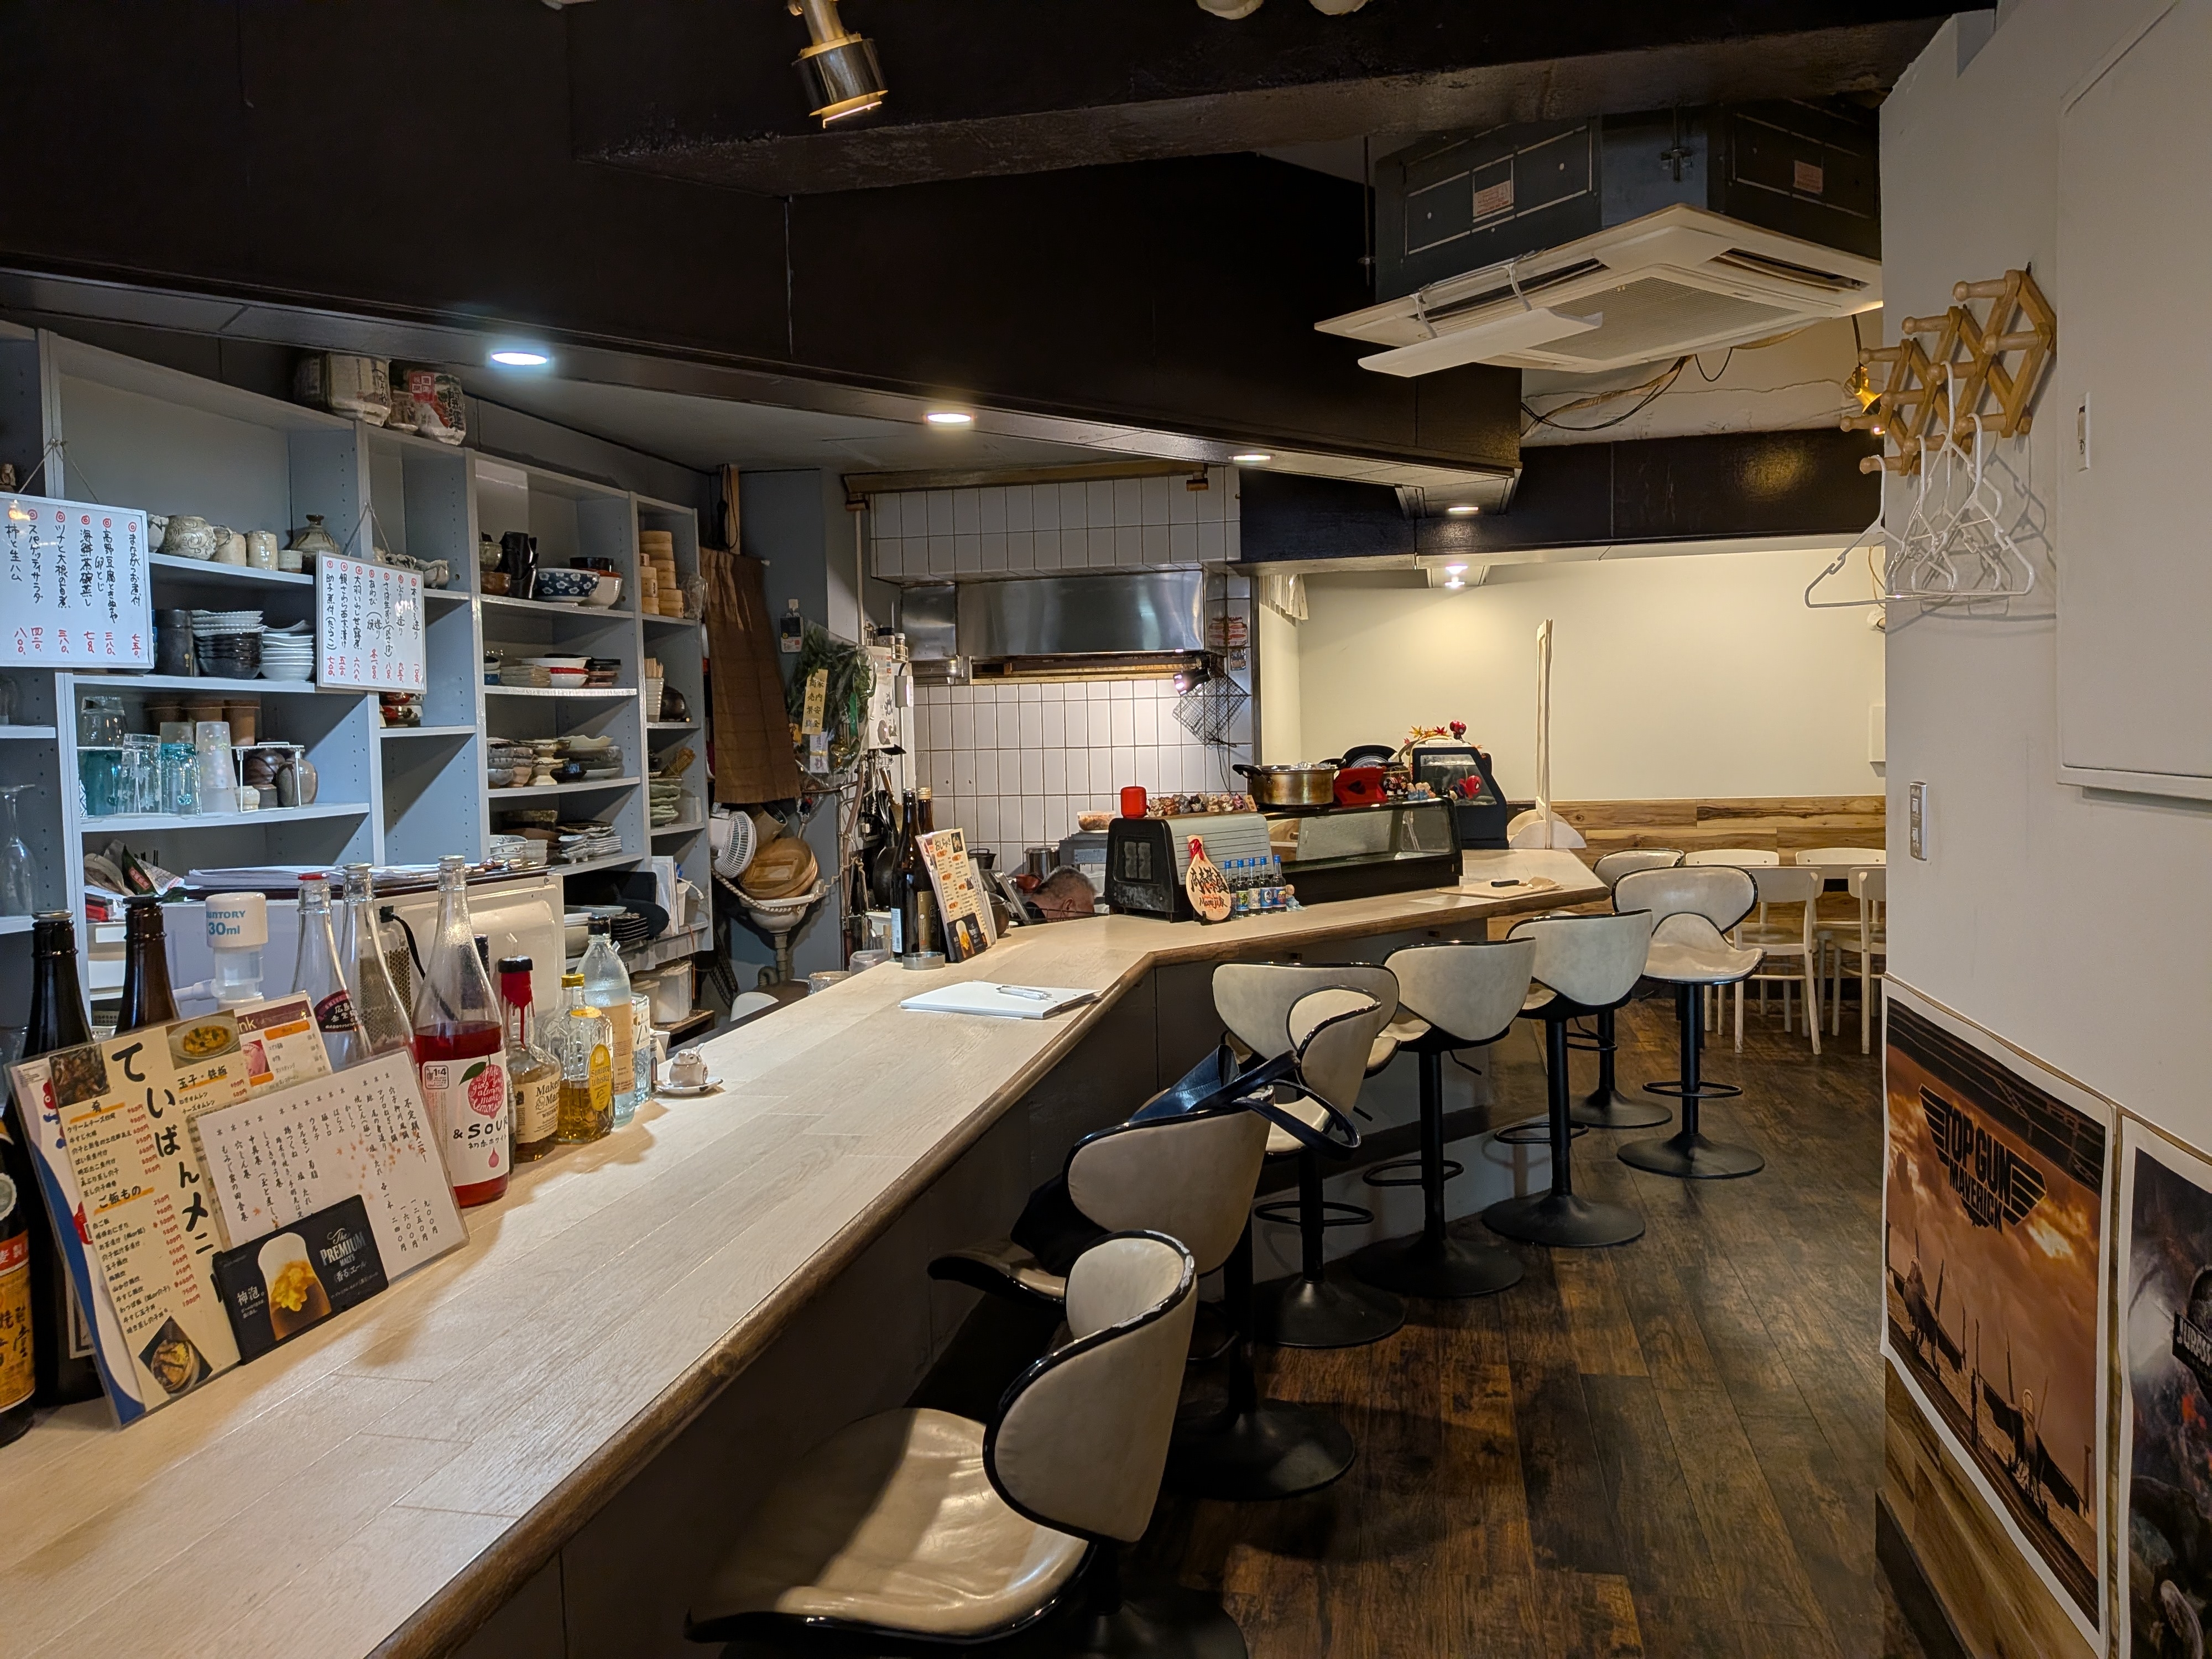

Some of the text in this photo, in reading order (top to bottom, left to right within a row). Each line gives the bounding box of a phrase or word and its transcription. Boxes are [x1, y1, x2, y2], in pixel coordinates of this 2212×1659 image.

[5, 524, 22, 582] 柿と生ハム
[80, 528, 94, 607] 海鮮茶碗蒸し
[95, 555, 105, 592] 卵とじ
[208, 921, 241, 936] 30ml
[453, 1115, 508, 1140] & SOUR
[98, 1185, 142, 1209] ご飯もの
[320, 1231, 366, 1266] PREMIUM
